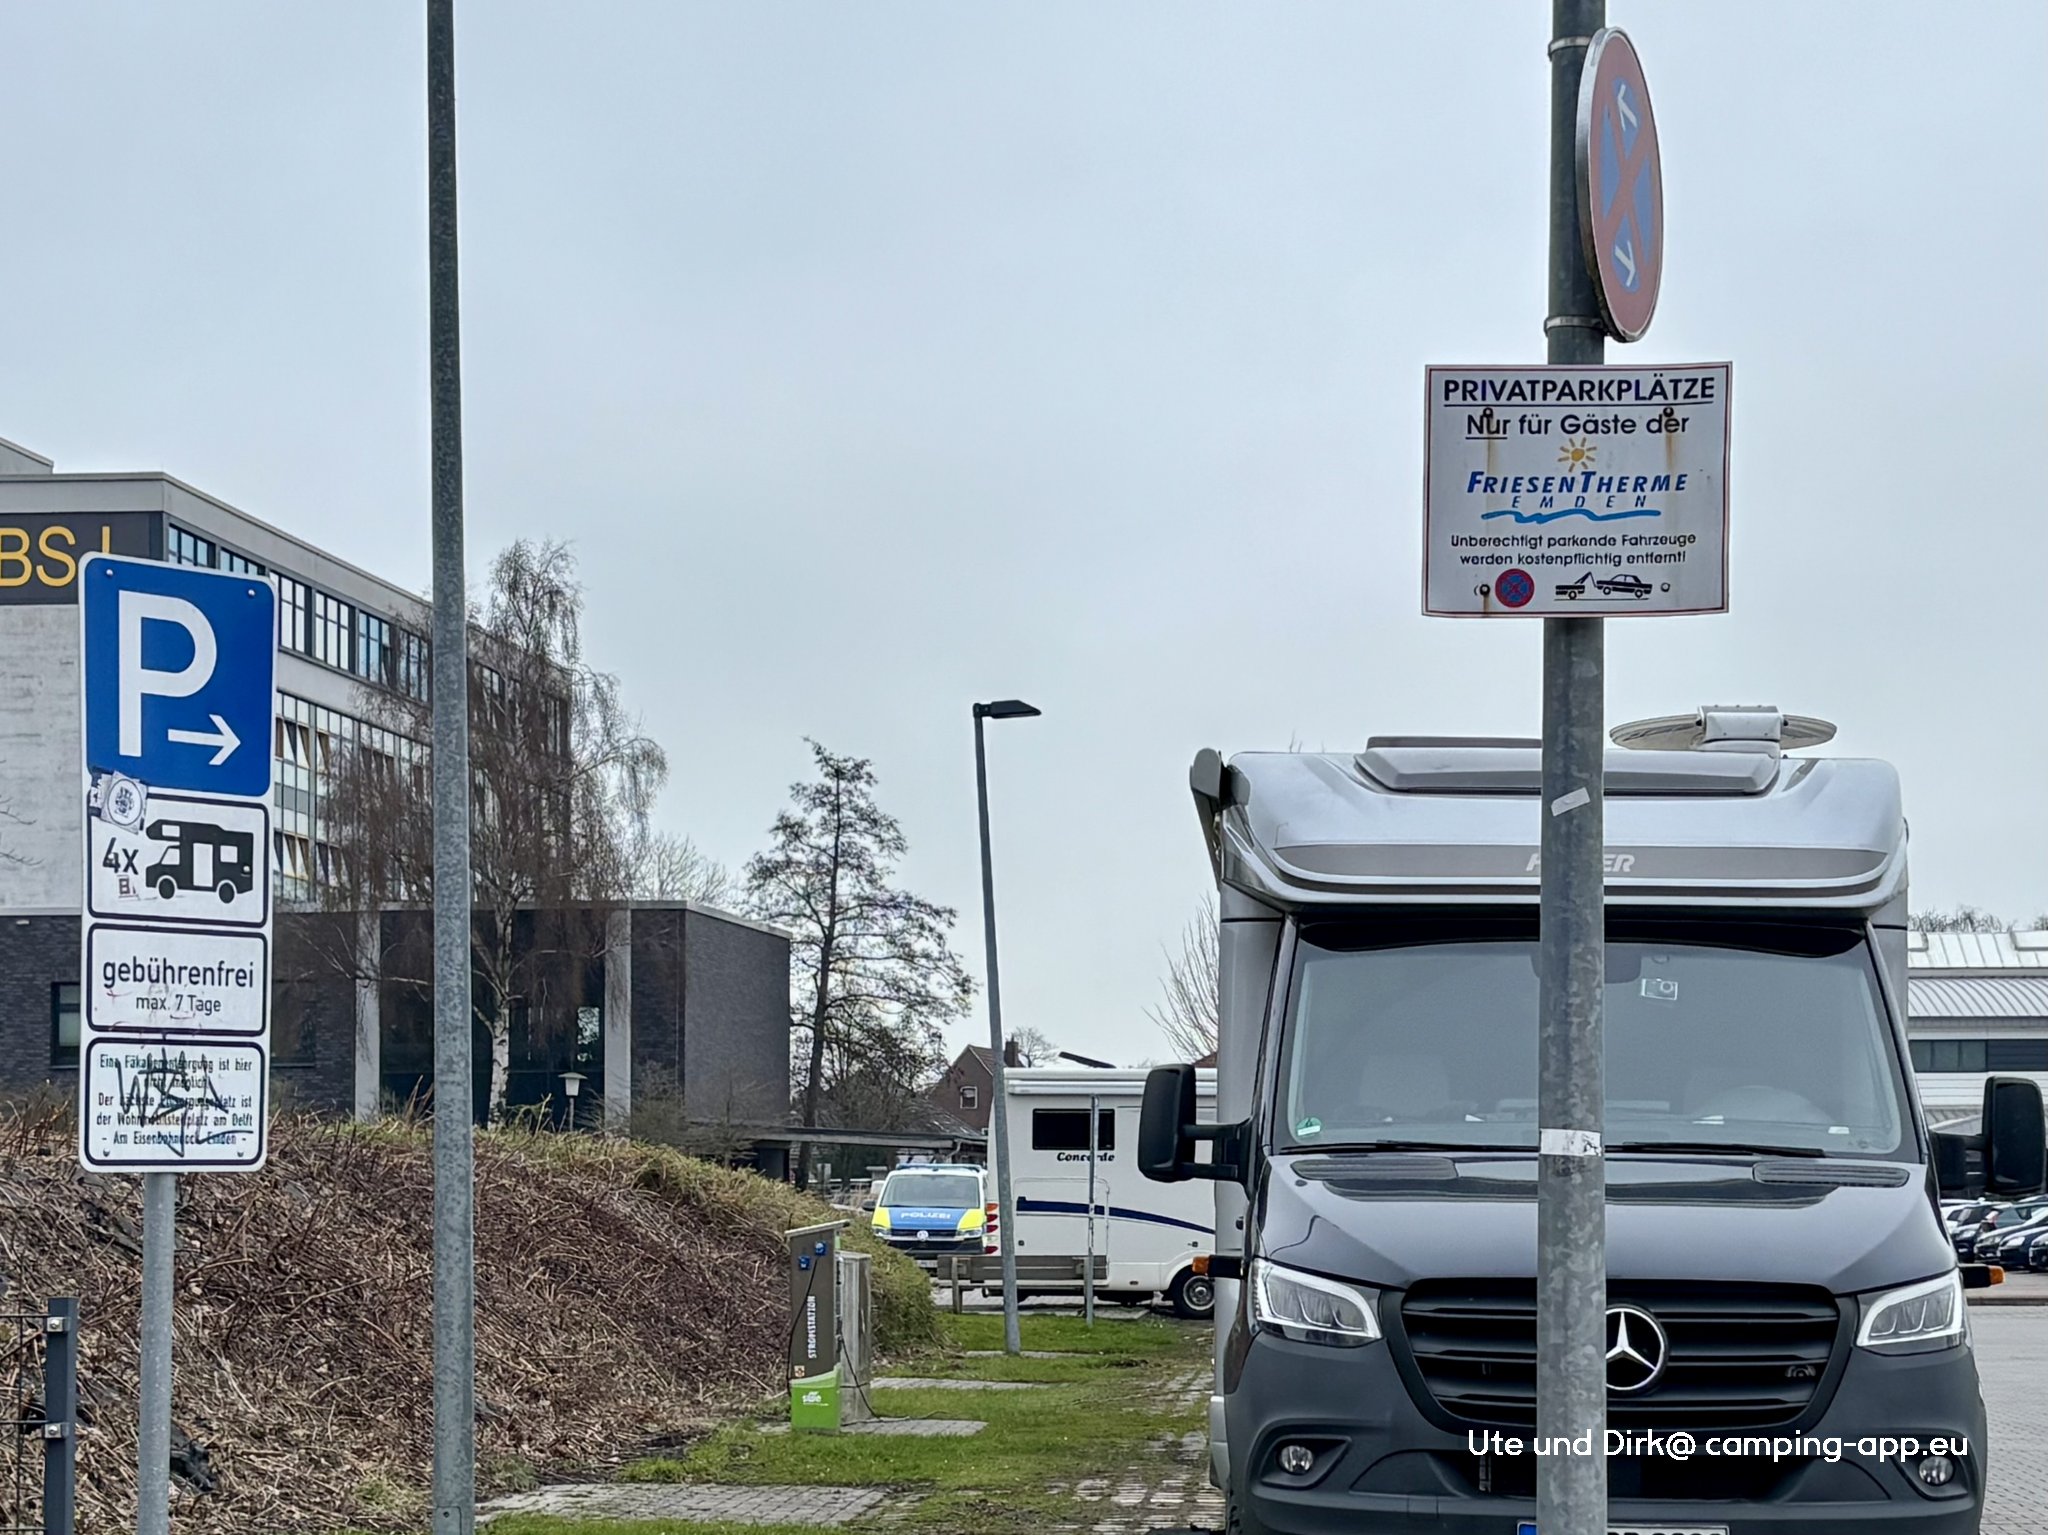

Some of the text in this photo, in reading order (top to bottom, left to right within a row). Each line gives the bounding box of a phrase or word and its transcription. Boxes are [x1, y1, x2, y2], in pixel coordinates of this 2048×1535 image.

[1444, 373, 1715, 402] PRIVATPARKPLÄTZE
[1467, 413, 1690, 435] Nur für Gäste der
[1451, 533, 1697, 550] Unberechtigt parkende Fahrzeuge
[1460, 553, 1513, 565] werden
[1517, 552, 1622, 568] kostenpflichtig
[118, 589, 218, 758] P
[102, 955, 254, 989] gebührenfrei
[136, 994, 222, 1017] max. 7 Tage
[218, 1058, 230, 1072] ist
[235, 1057, 252, 1072] hier
[98, 1092, 114, 1106] Der
[241, 1094, 252, 1108] ist
[96, 1113, 111, 1126] der
[214, 1116, 227, 1126] am
[232, 1112, 253, 1127] Delft
[114, 1130, 128, 1145] Am
